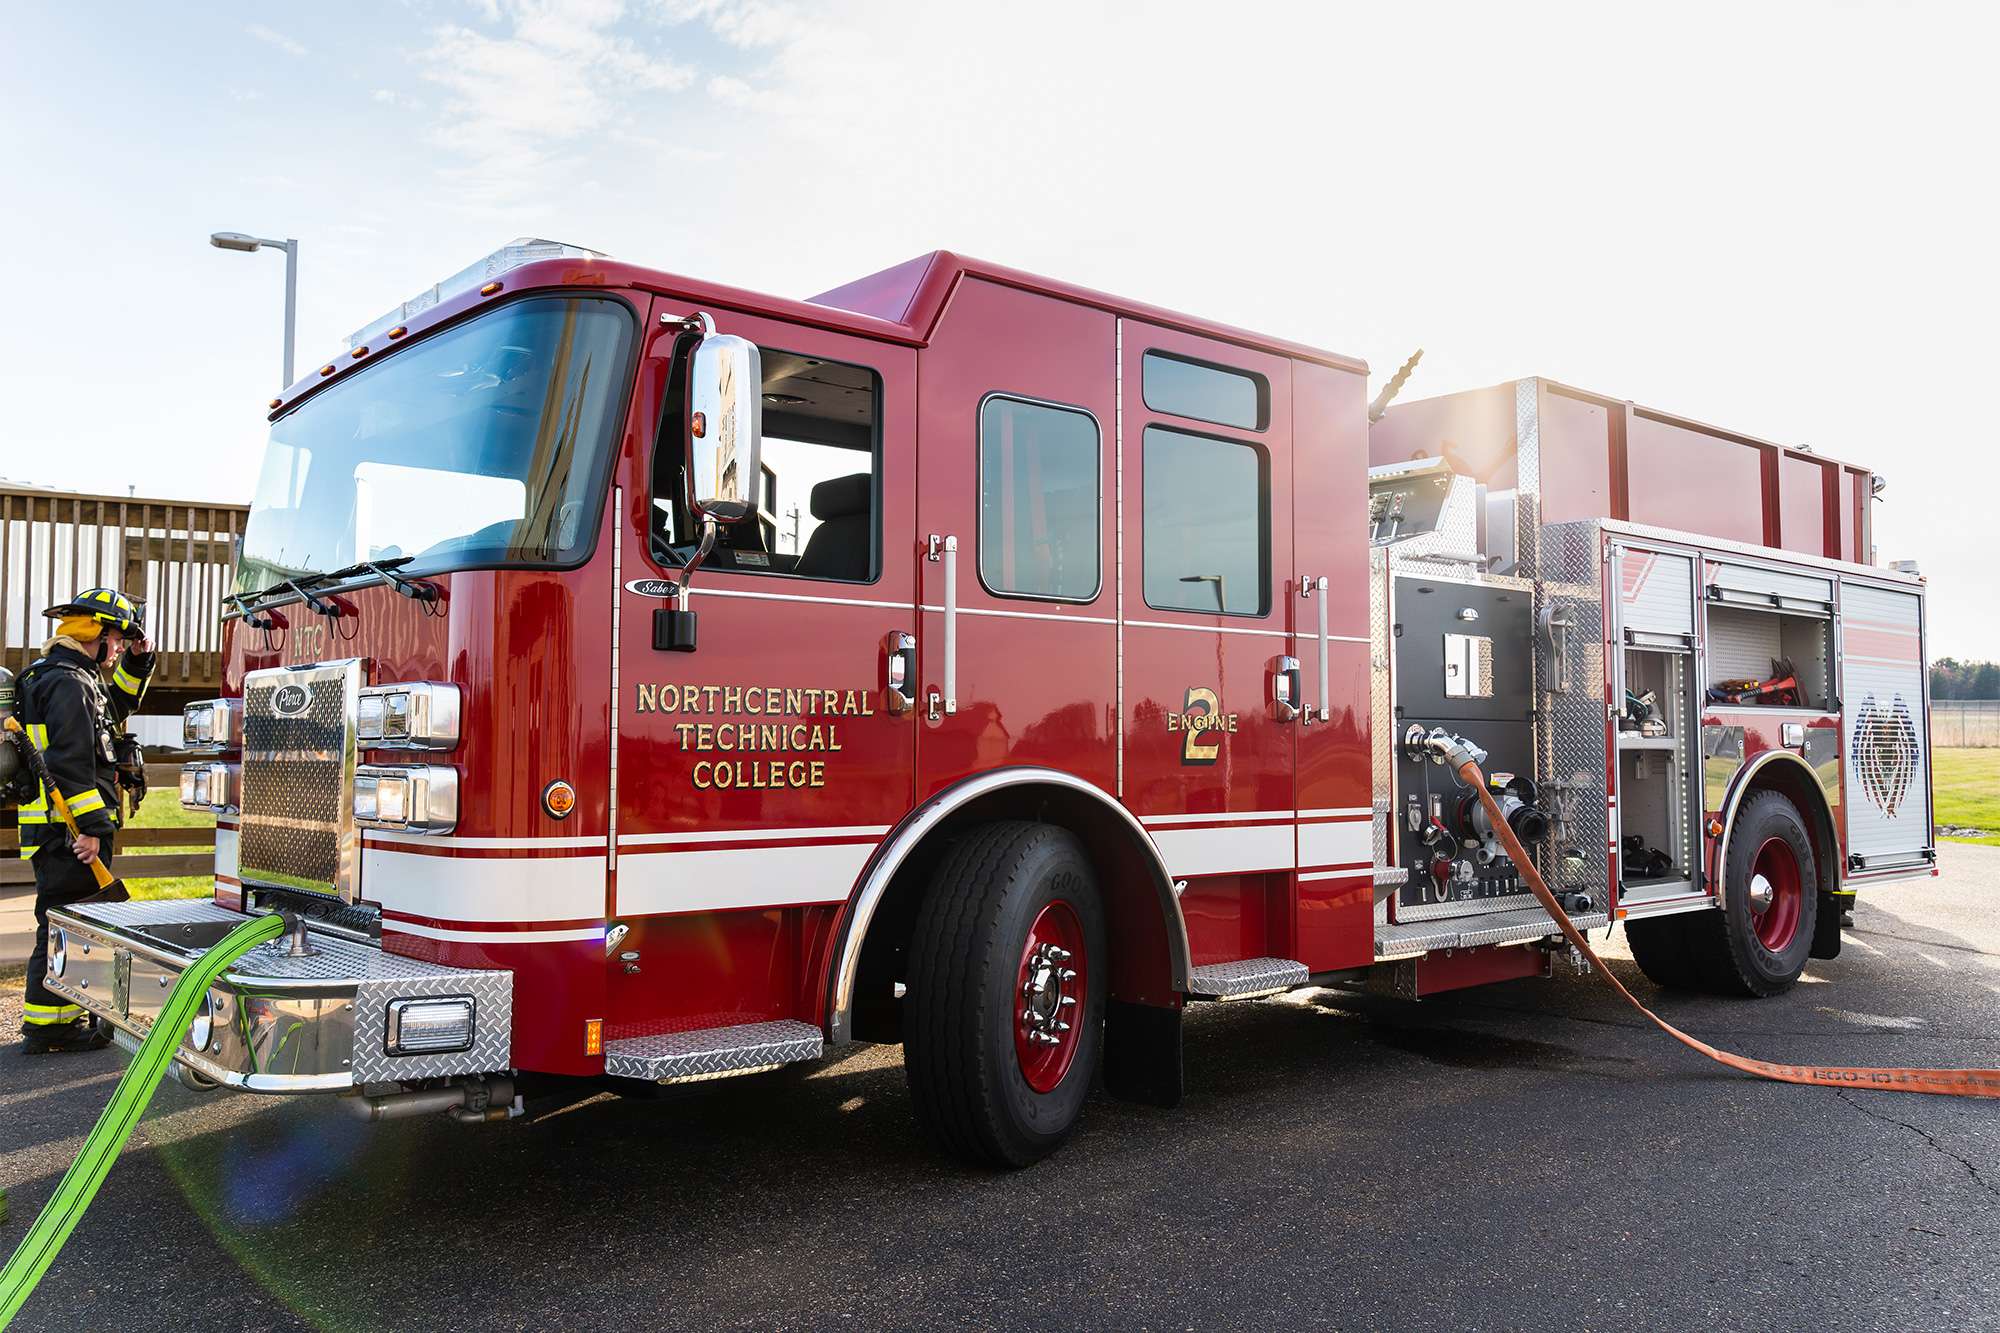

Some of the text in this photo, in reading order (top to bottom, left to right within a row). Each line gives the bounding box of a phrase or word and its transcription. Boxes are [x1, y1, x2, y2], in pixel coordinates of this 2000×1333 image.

[642, 581, 676, 594] Saber
[294, 624, 322, 657] NTC
[279, 688, 302, 710] Pierce
[637, 684, 874, 716] NORTHCENTRAL
[1167, 712, 1238, 732] ENGINE
[1183, 687, 1219, 763] 2
[675, 723, 842, 751] TECHNICAL
[692, 760, 825, 790] COLLEGE
